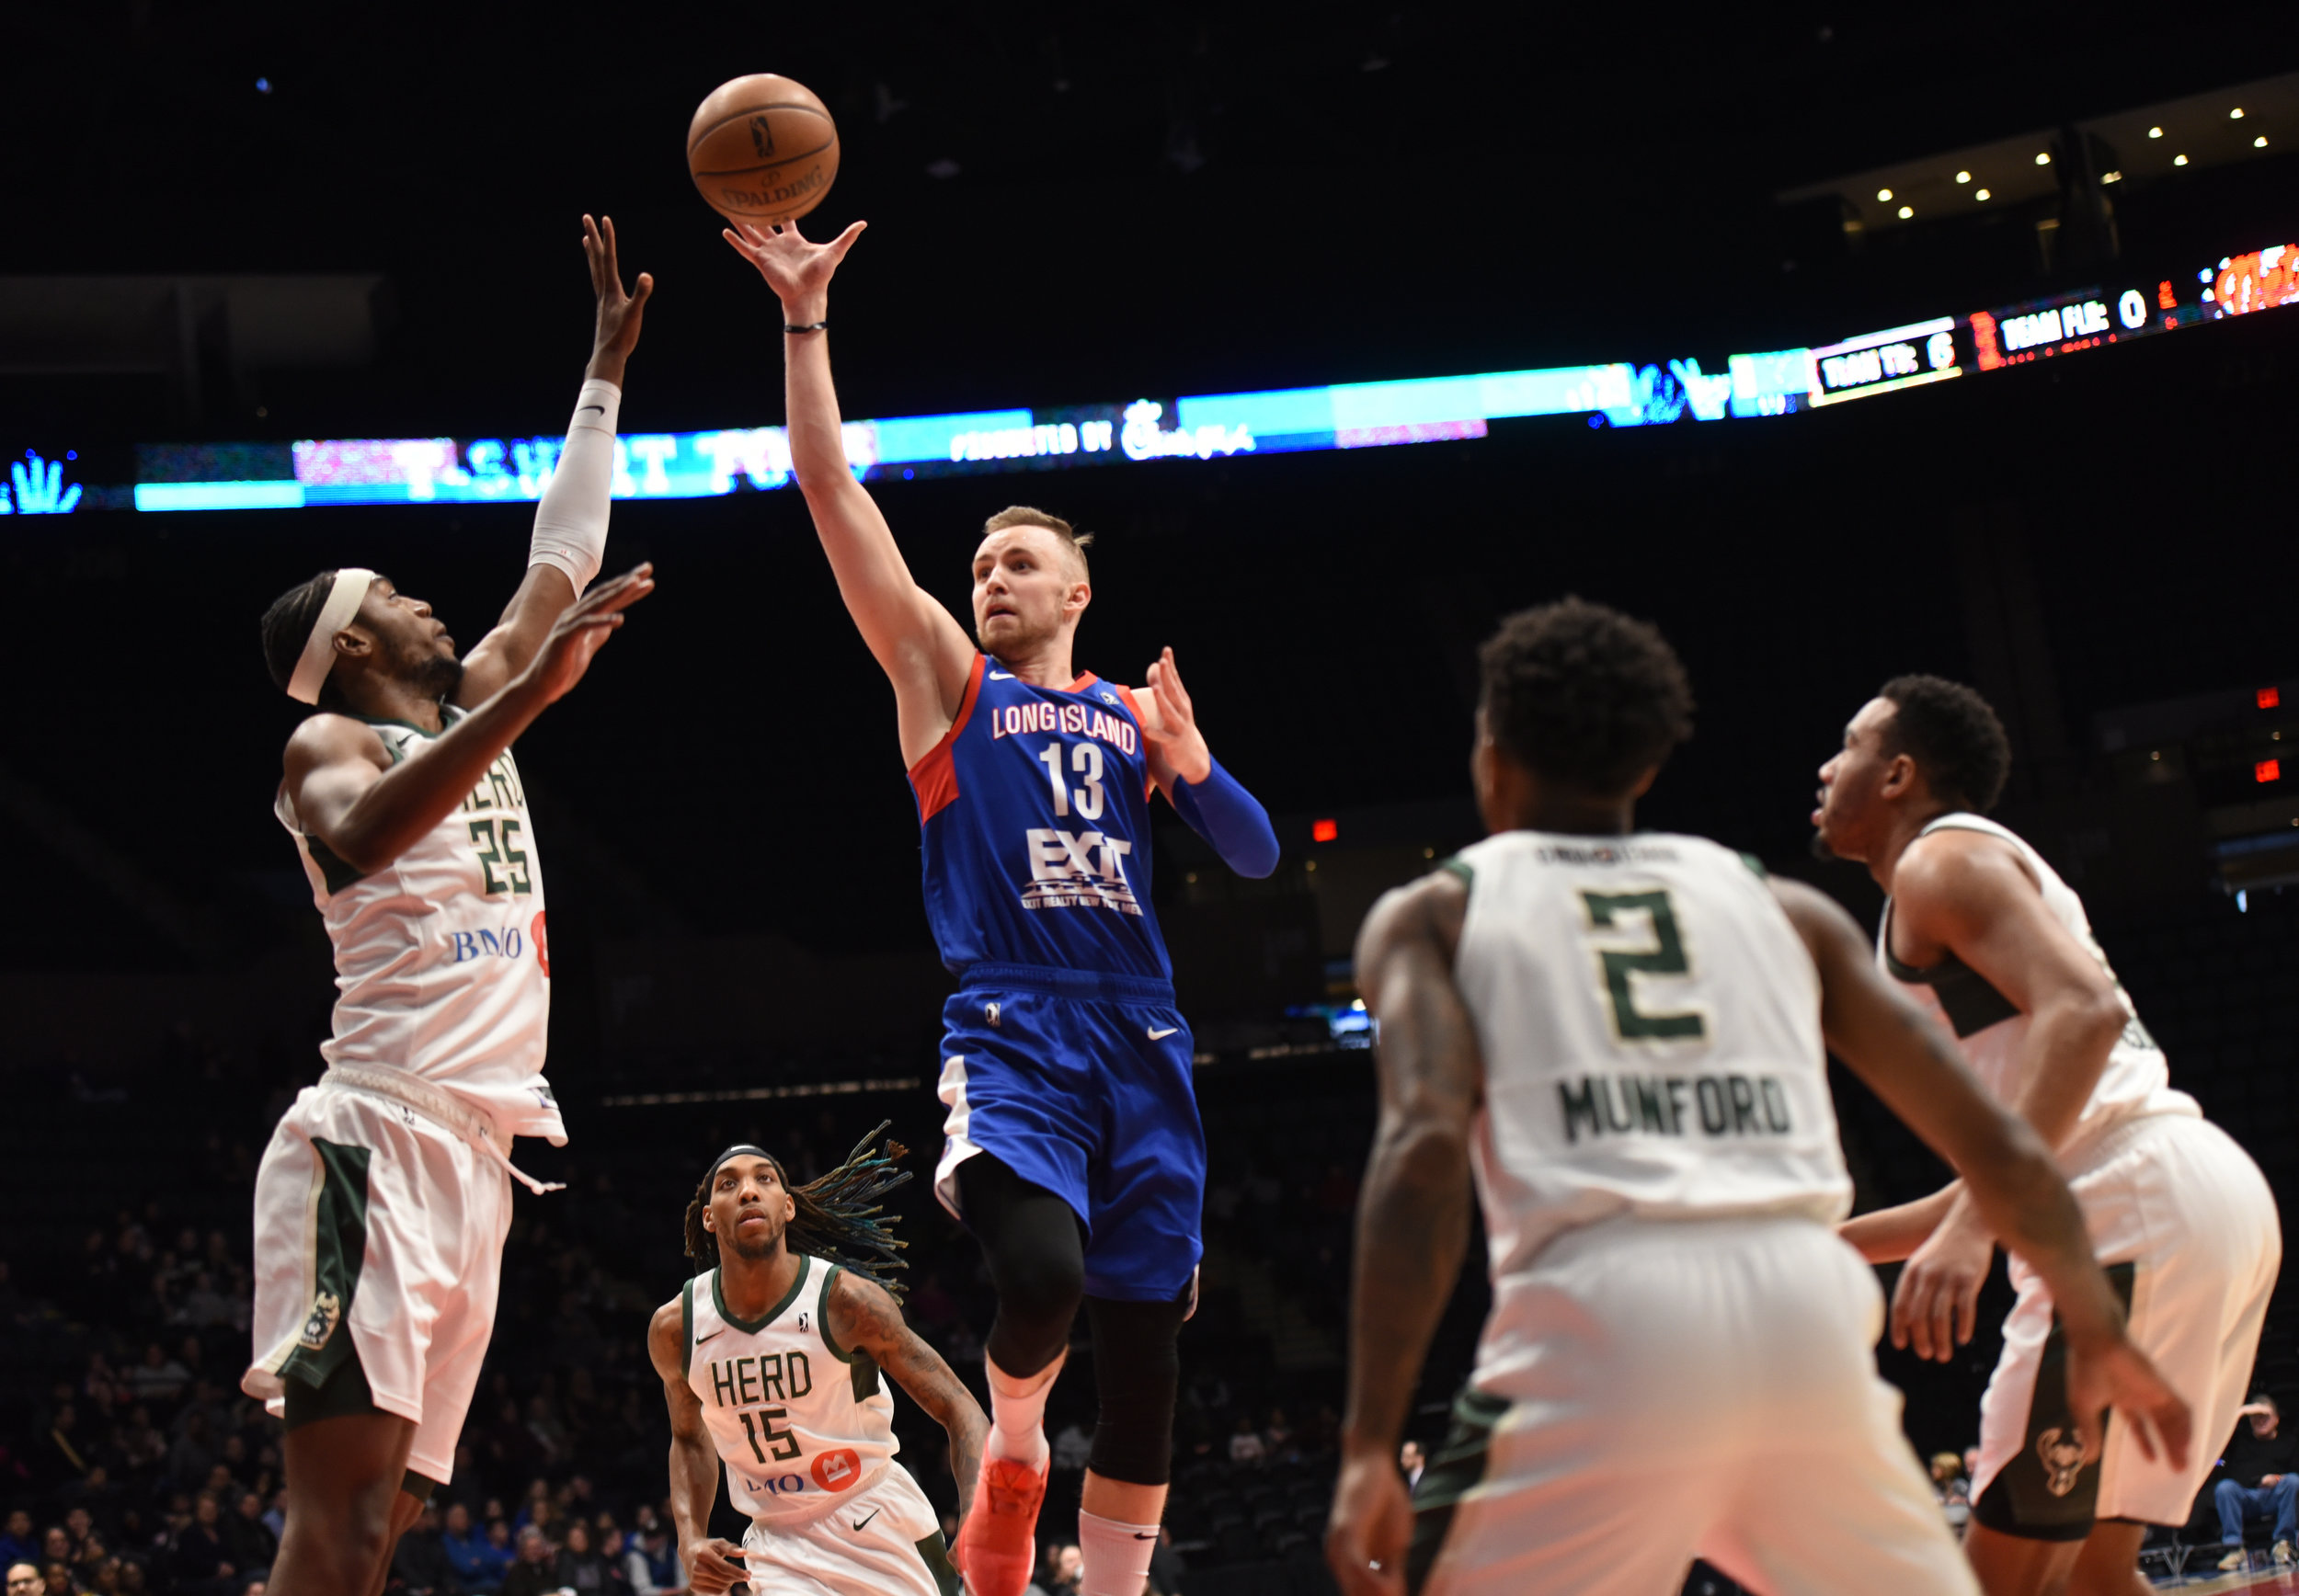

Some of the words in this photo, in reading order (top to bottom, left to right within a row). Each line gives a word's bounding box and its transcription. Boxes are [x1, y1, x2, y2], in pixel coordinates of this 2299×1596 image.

[721, 165, 826, 208] SPALDING
[1926, 331, 1956, 370] 6
[2000, 309, 2063, 351] TEAM
[2118, 289, 2147, 329] 0
[992, 702, 1057, 740] LONG
[1058, 704, 1137, 756] ISLAND
[463, 751, 523, 813] ERD
[1039, 742, 1104, 820] 13
[469, 818, 532, 895] 25
[1576, 886, 1712, 1044] 2
[1557, 1073, 1792, 1143] MUNFORD
[711, 1351, 812, 1408] HERD
[739, 1408, 803, 1465] 15
